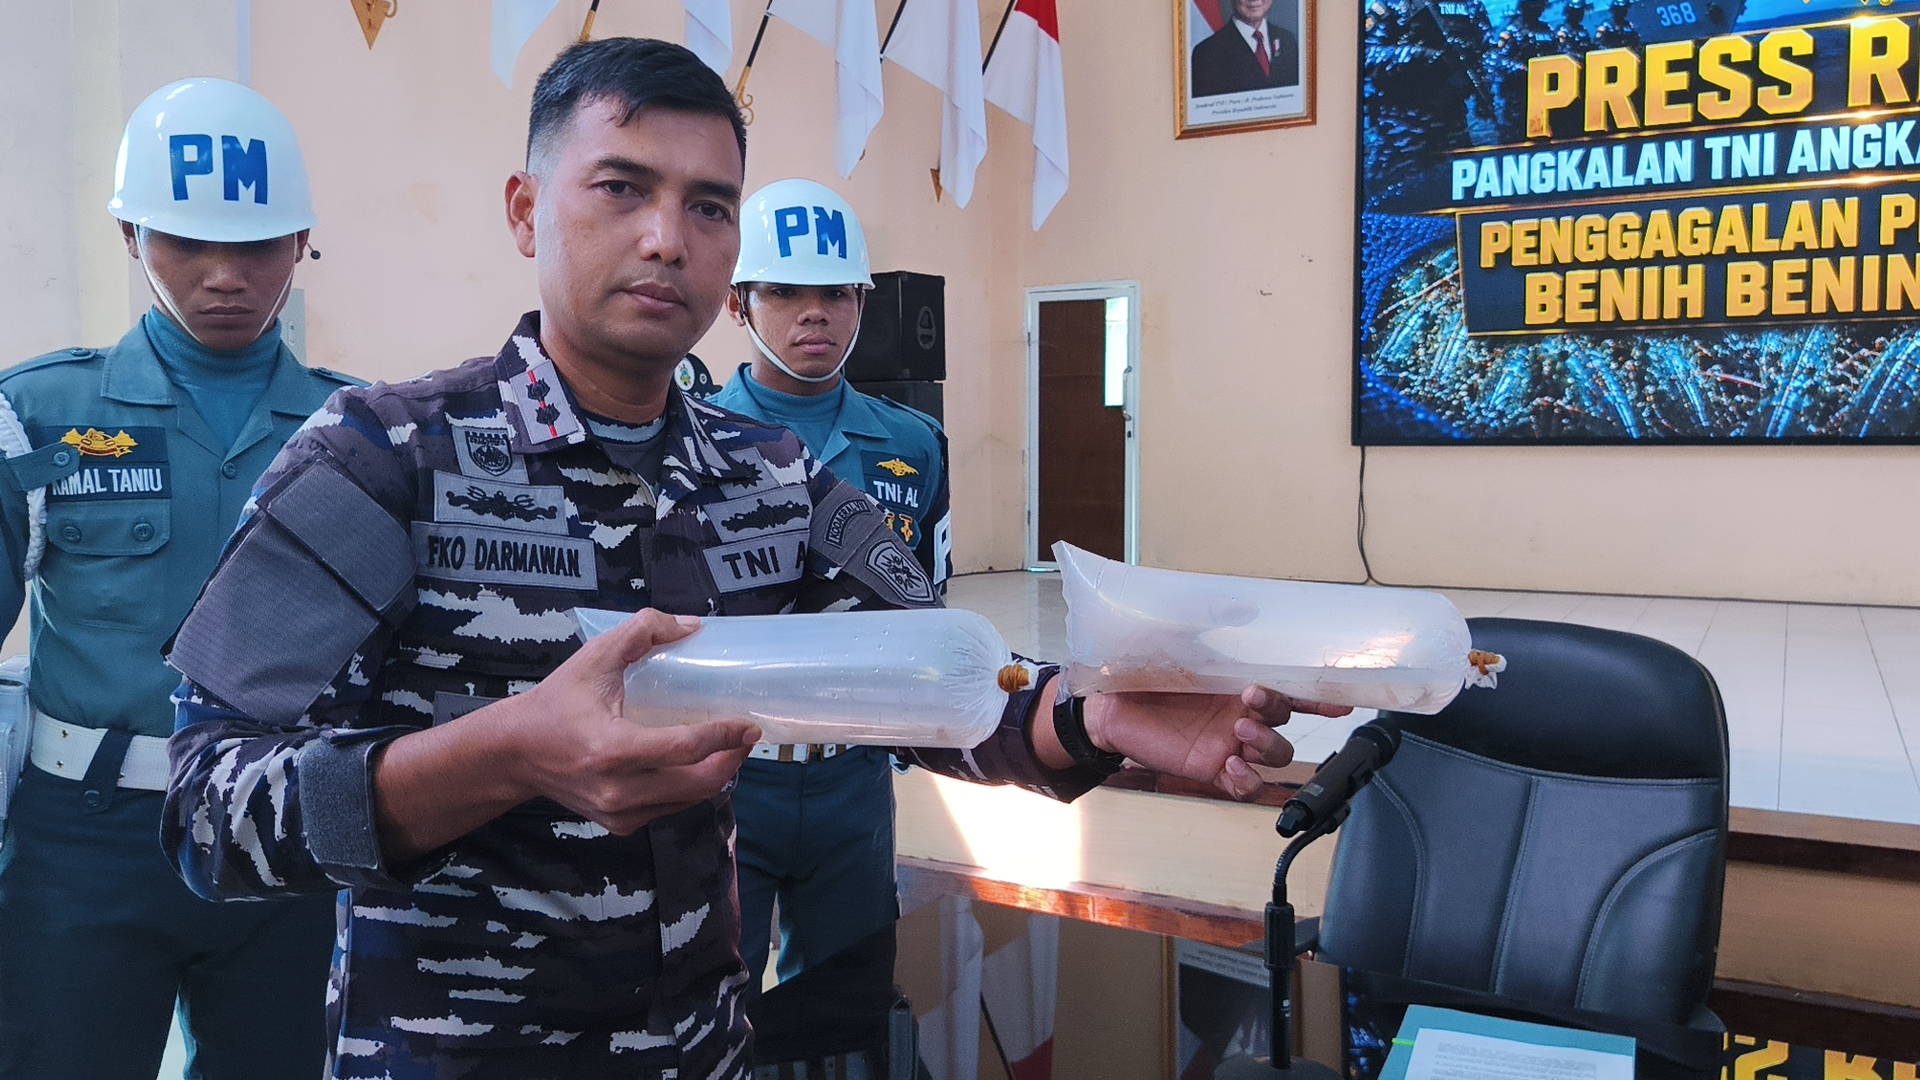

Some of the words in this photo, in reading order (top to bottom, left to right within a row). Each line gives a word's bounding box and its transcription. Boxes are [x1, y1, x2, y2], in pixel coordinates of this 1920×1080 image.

[1656, 1, 1698, 27] 368
[1526, 29, 1815, 138] PRESS
[1847, 16, 1920, 108] R
[169, 134, 268, 205] PM
[1451, 138, 1695, 201] PANGKALAN
[1703, 131, 1776, 181] TNI
[1786, 119, 1920, 174] ANGK
[775, 206, 847, 260] PM
[1480, 196, 1859, 269] PENGGAGALAN
[1880, 193, 1920, 247] P
[1525, 263, 1706, 326] BENIH
[1726, 252, 1920, 319] BENIN
[107, 468, 163, 493] TANIU
[904, 486, 919, 509] AL
[474, 538, 582, 578] DARMAWAN
[721, 546, 781, 580] TNI
